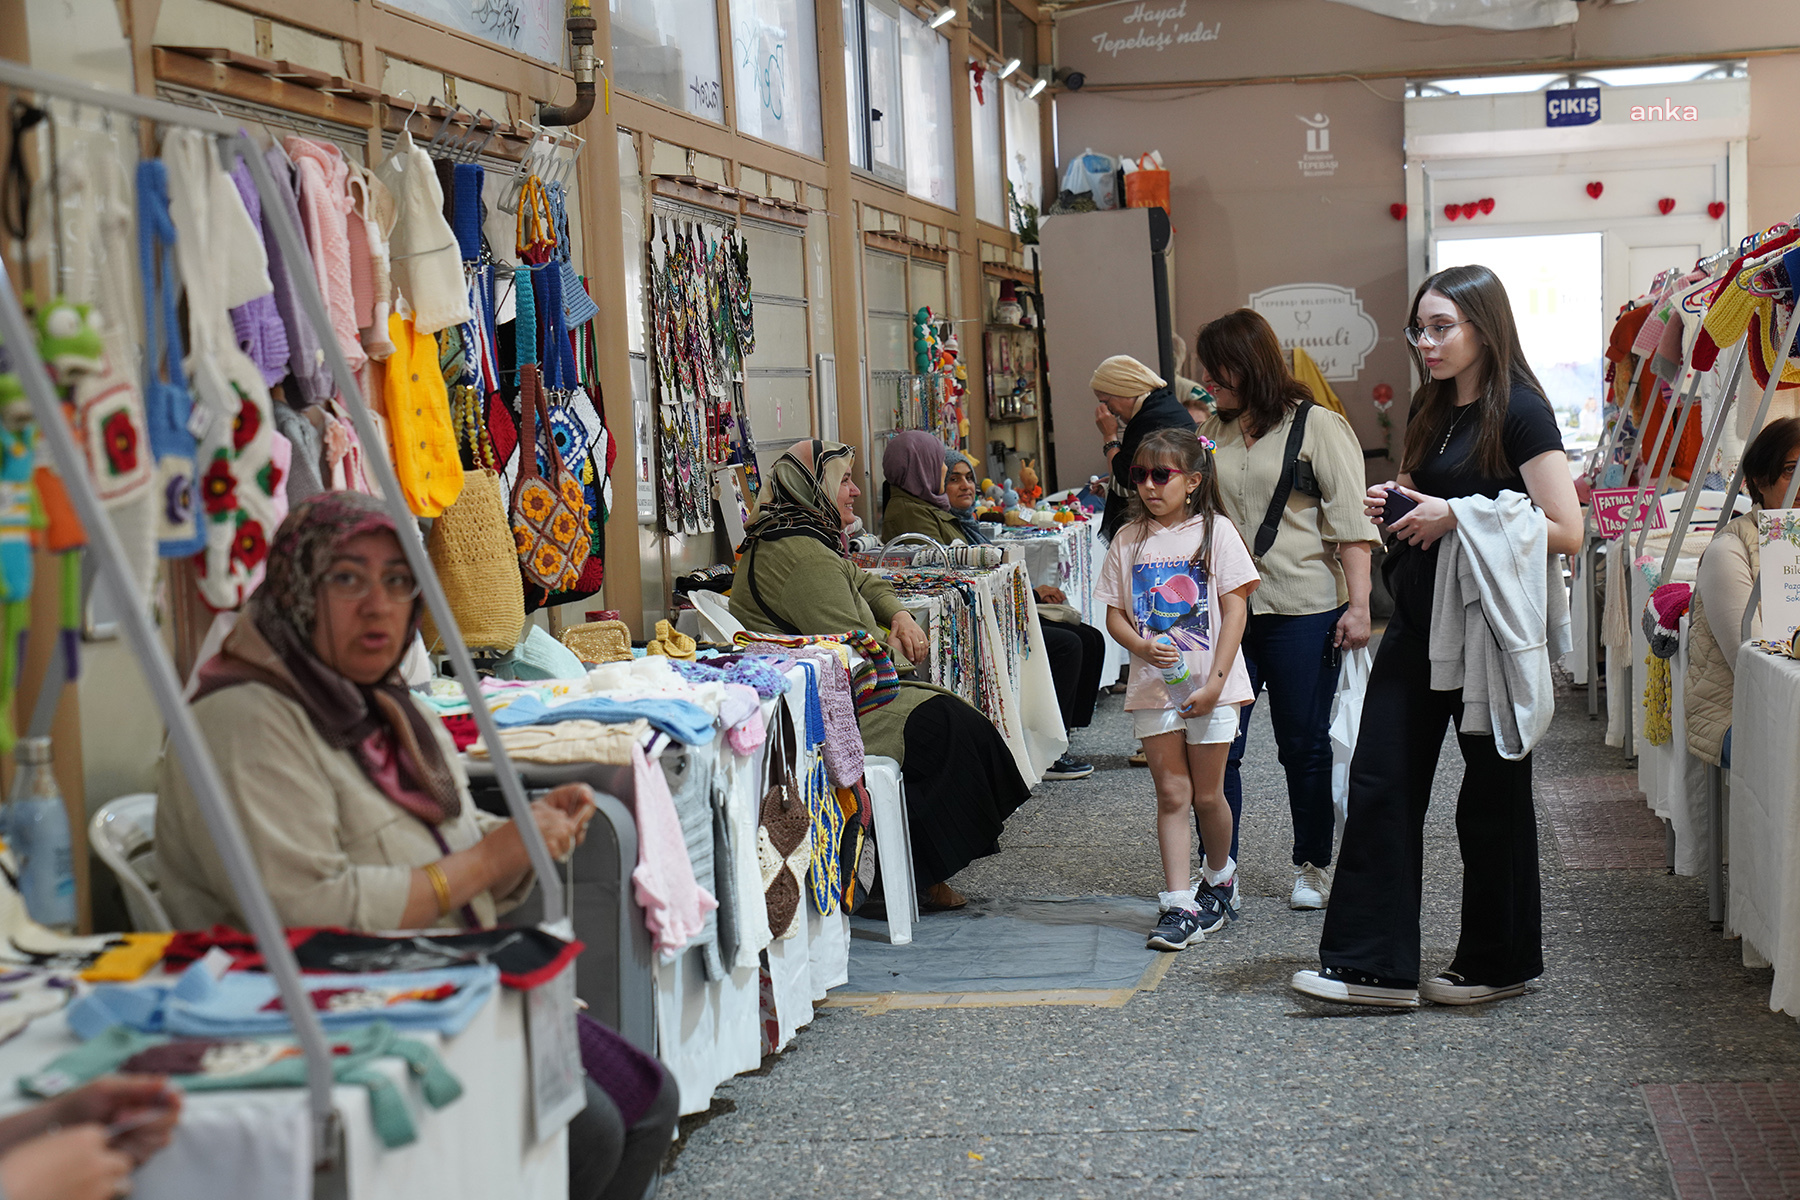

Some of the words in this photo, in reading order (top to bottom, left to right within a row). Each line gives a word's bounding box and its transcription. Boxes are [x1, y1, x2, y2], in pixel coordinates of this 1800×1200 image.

[1123, 0, 1186, 27] Hayat
[1548, 97, 1599, 119] ÇIKIŞ
[1598, 495, 1631, 511] FATMA
[1602, 516, 1643, 531] TASAIM
